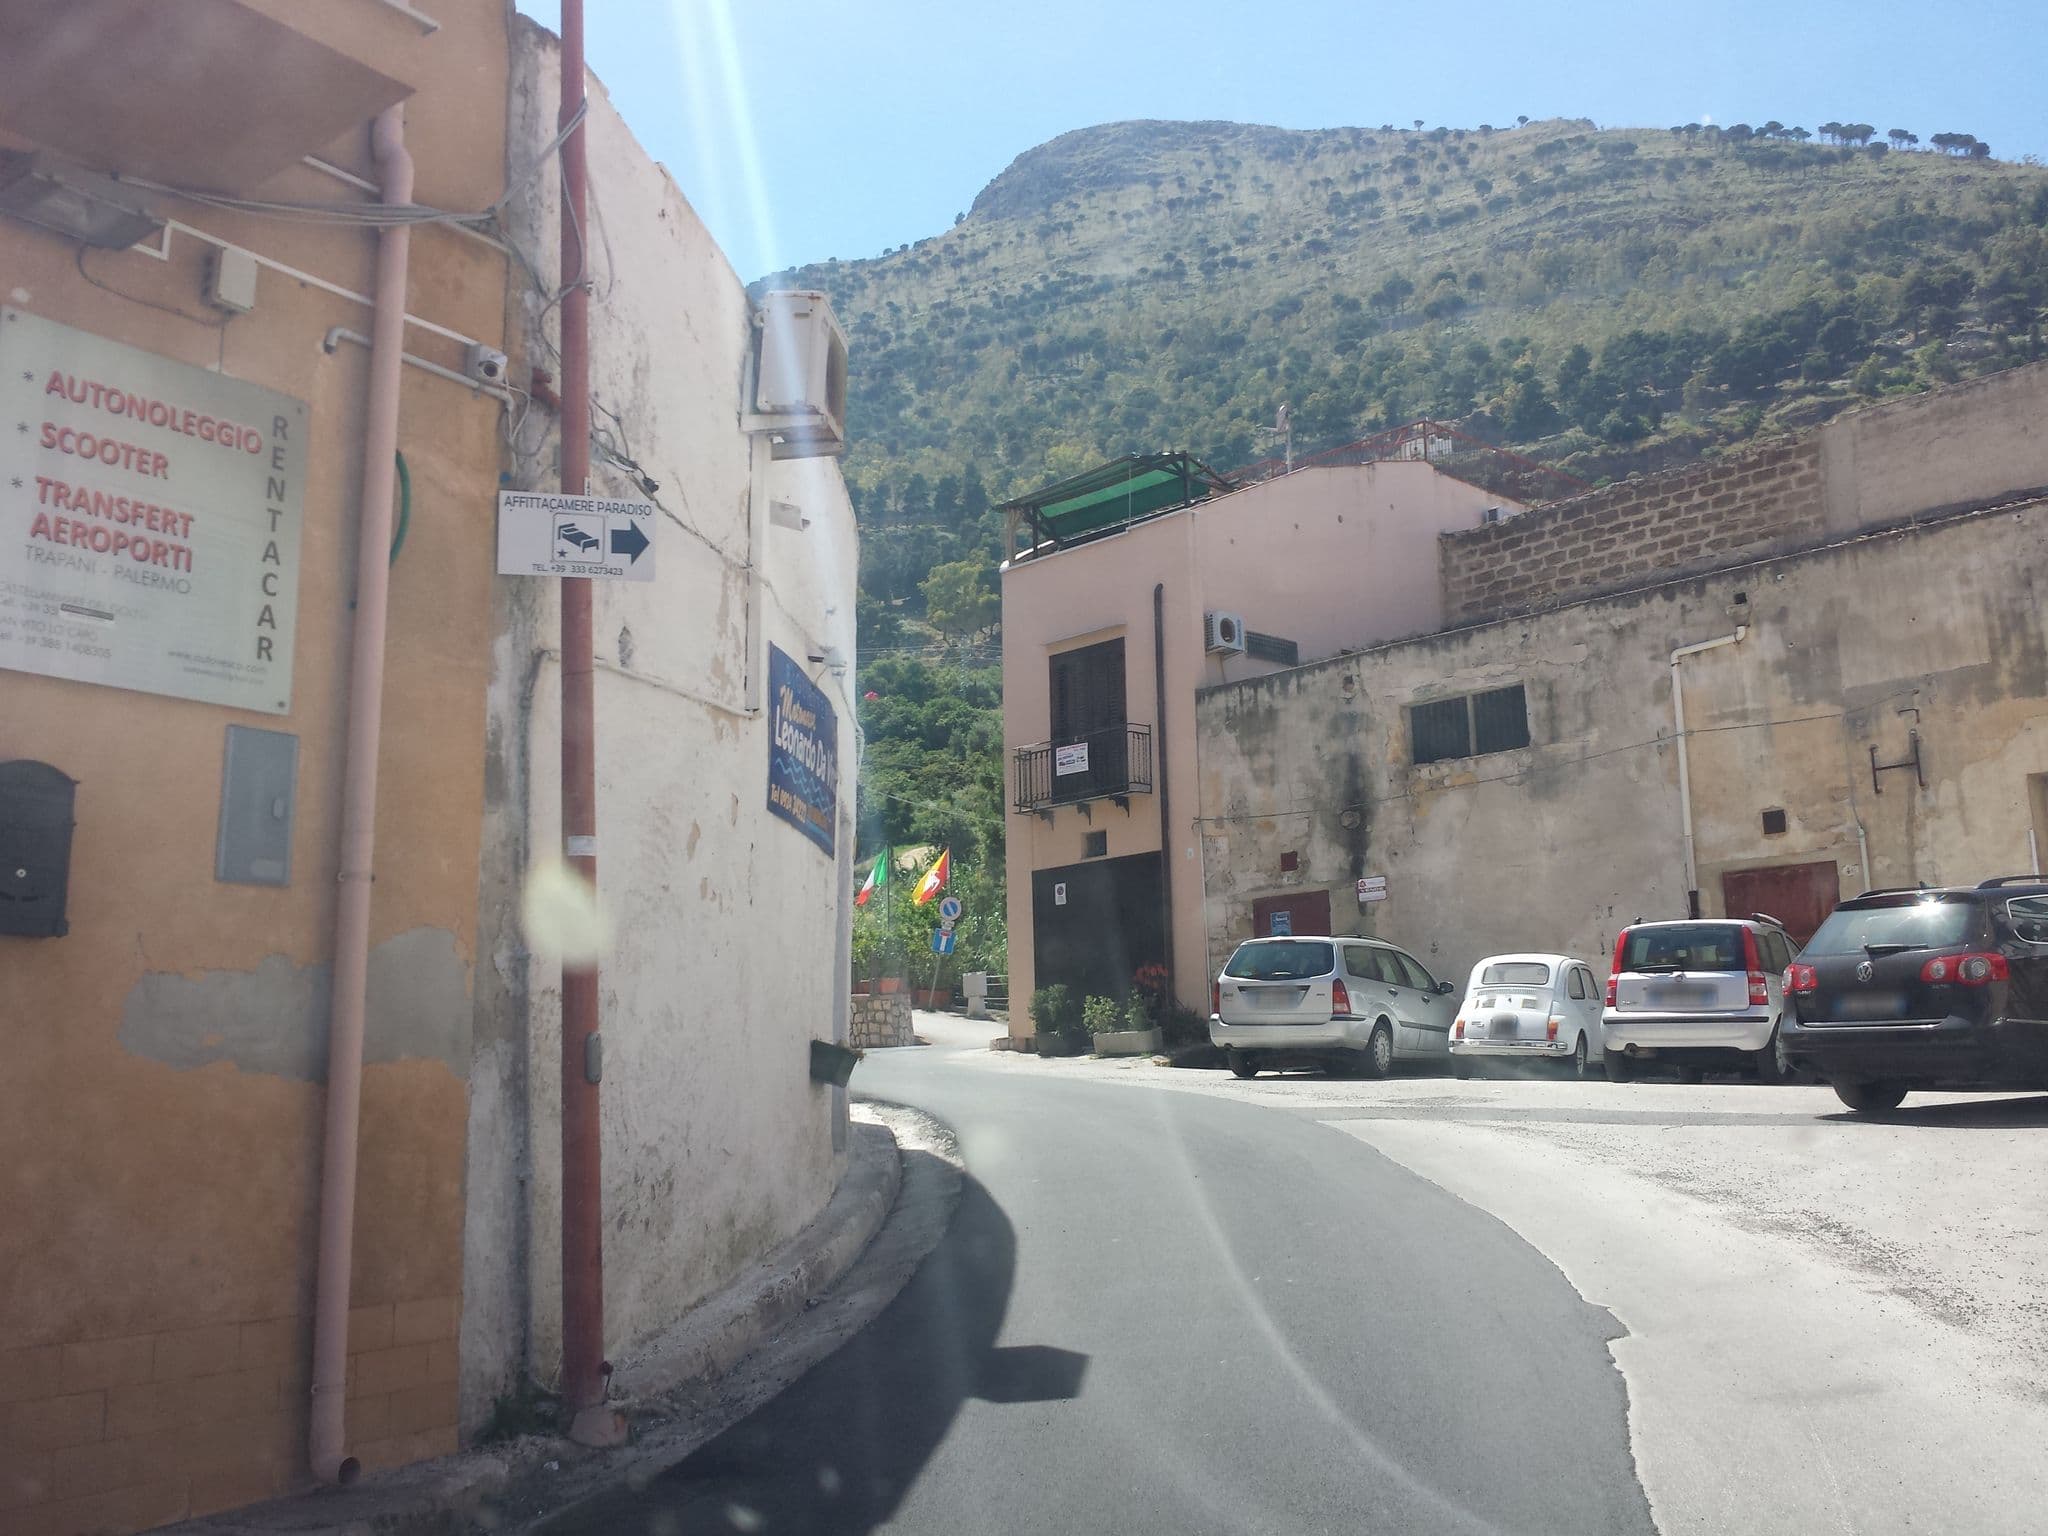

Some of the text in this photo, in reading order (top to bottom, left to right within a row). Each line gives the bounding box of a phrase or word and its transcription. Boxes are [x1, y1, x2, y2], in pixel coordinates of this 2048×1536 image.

[45, 369, 263, 455] AUTONOLEGGIO
[40, 421, 169, 480] SCOOTER
[36, 475, 195, 539] TRANSFERT
[504, 495, 652, 516] AFFITTACAMERE PARADISO
[24, 544, 97, 575] TRAPANI
[113, 563, 192, 595] PALERMO
[29, 511, 193, 573] AEROPORTI
[775, 704, 816, 772] Leonardo
